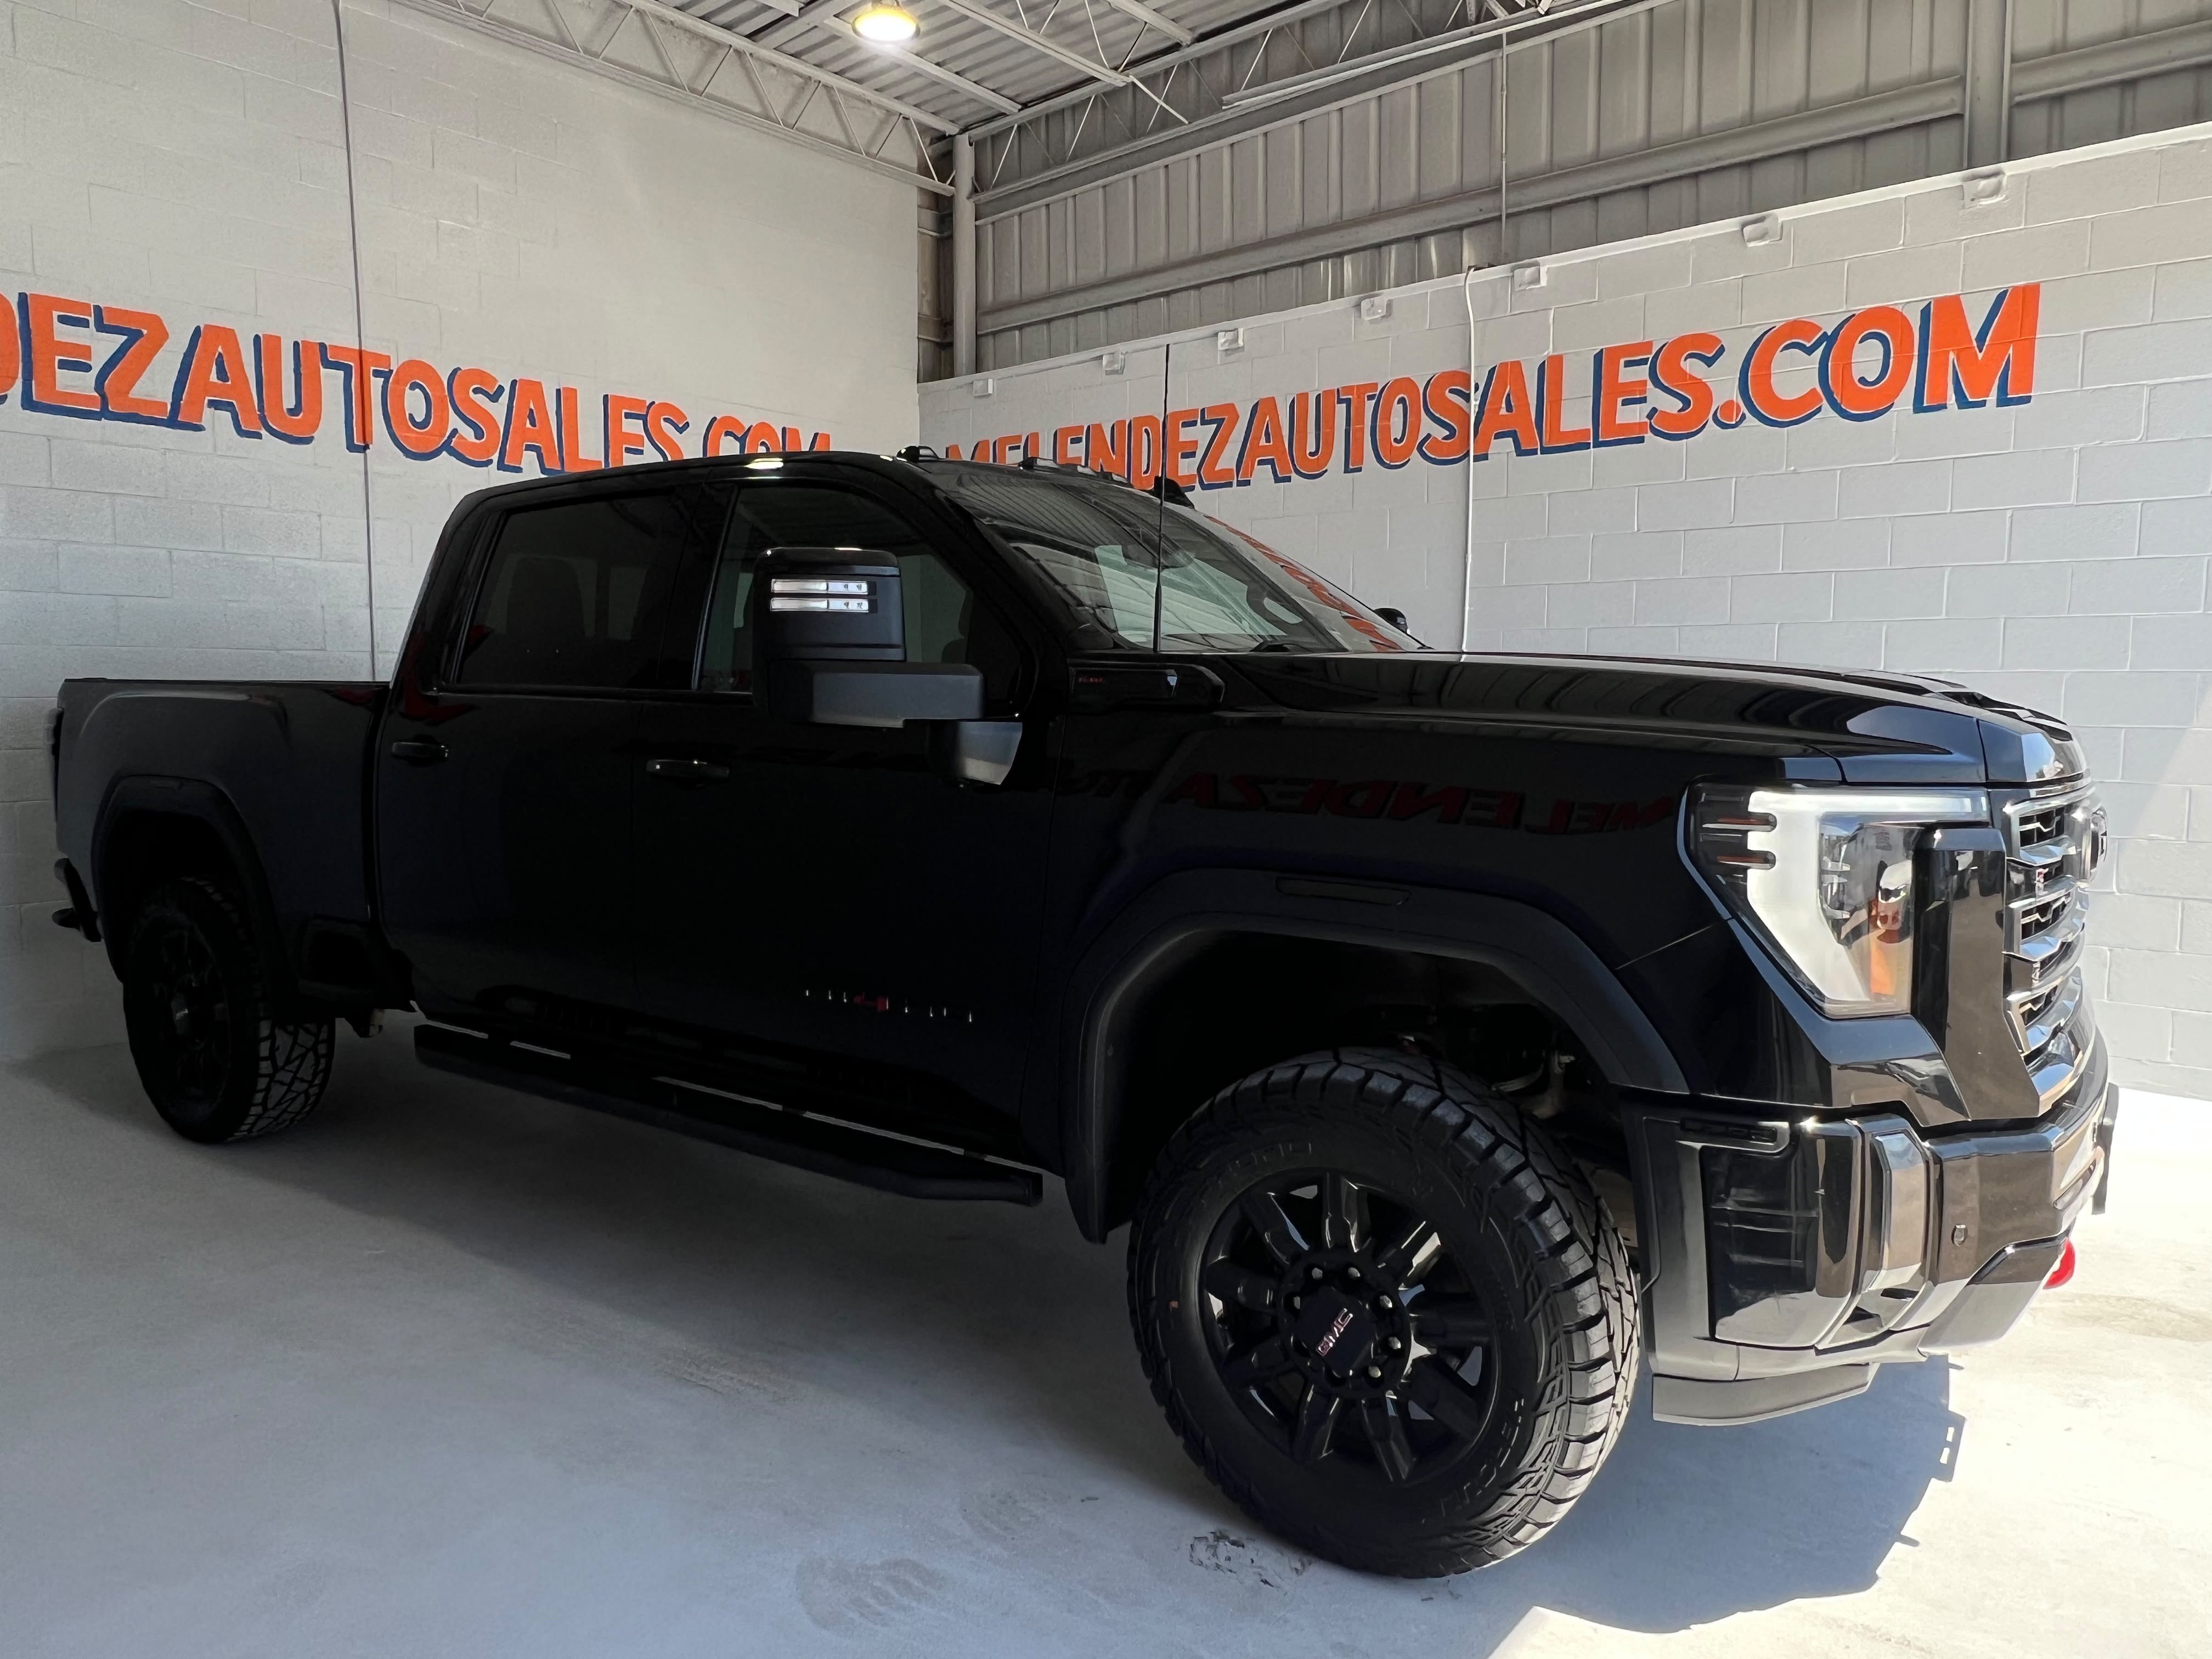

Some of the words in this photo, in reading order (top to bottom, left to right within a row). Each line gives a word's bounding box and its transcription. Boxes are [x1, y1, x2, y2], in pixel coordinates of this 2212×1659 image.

[0, 291, 830, 477] EZAUTOSALESC
[945, 282, 2040, 492] ENDEZAUTOSALES.COM
[1316, 1308, 1353, 1356] GMC
